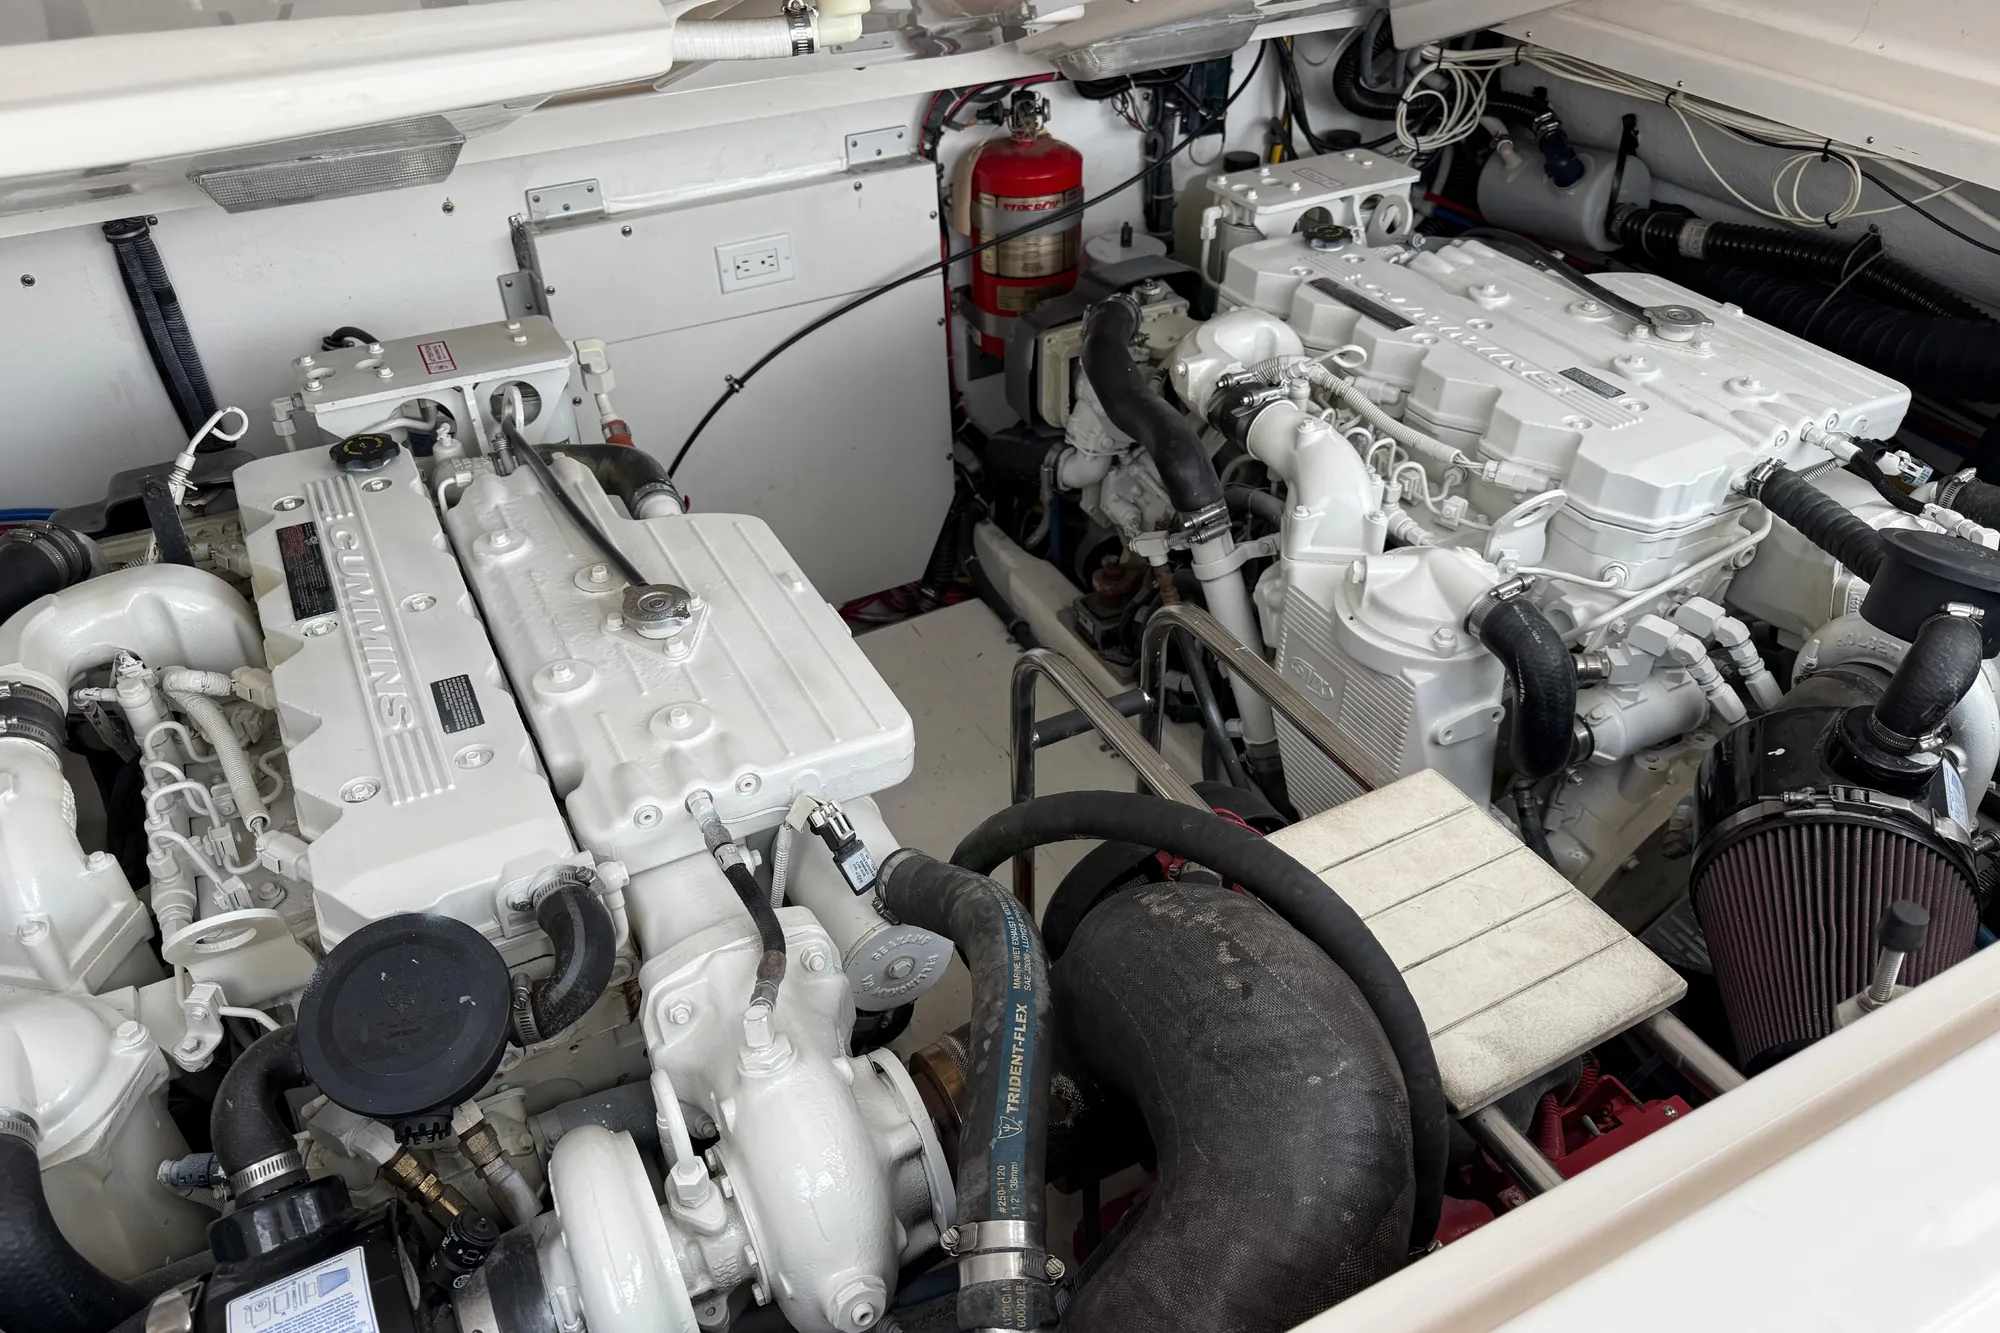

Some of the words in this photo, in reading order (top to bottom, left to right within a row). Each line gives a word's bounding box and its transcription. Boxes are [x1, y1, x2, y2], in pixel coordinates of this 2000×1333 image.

[1355, 279, 1568, 394] CUMMINS
[329, 523, 416, 730] CUMMINS
[1008, 920, 1020, 946] EXHAUST
[1018, 924, 1030, 948] LLOYDS
[1013, 962, 1022, 990] MARINE
[1023, 974, 1032, 991] SAE
[1006, 1003, 1028, 1113] TRIDENT-FLEX
[996, 1165, 1008, 1214] #250-1120
[1010, 1161, 1018, 1190] (38mm)
[1016, 1298, 1026, 1328] 60002
